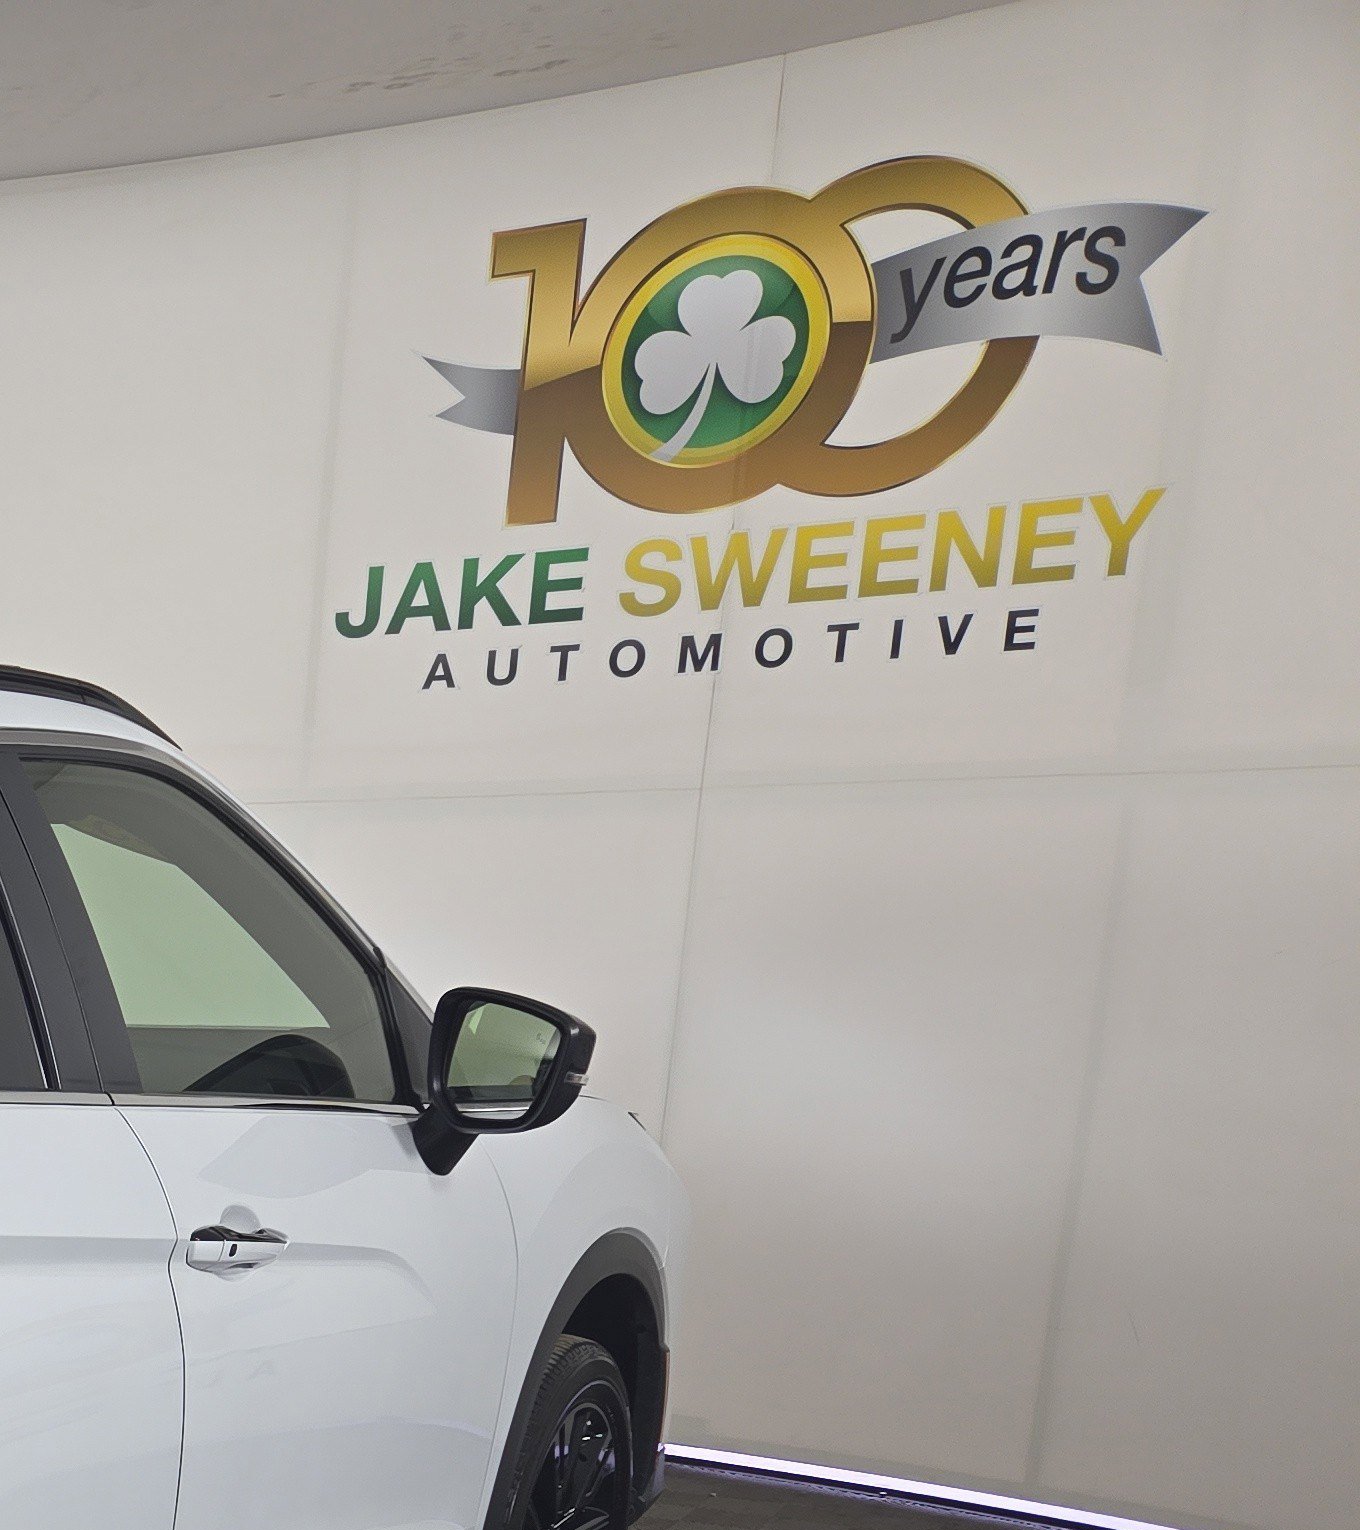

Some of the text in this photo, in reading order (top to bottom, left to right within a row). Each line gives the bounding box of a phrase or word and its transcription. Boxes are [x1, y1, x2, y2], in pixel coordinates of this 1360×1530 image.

[889, 223, 1127, 343] years
[334, 486, 1168, 639] JAKE SWEENEY
[421, 608, 1042, 692] AUTOMOTIVE
